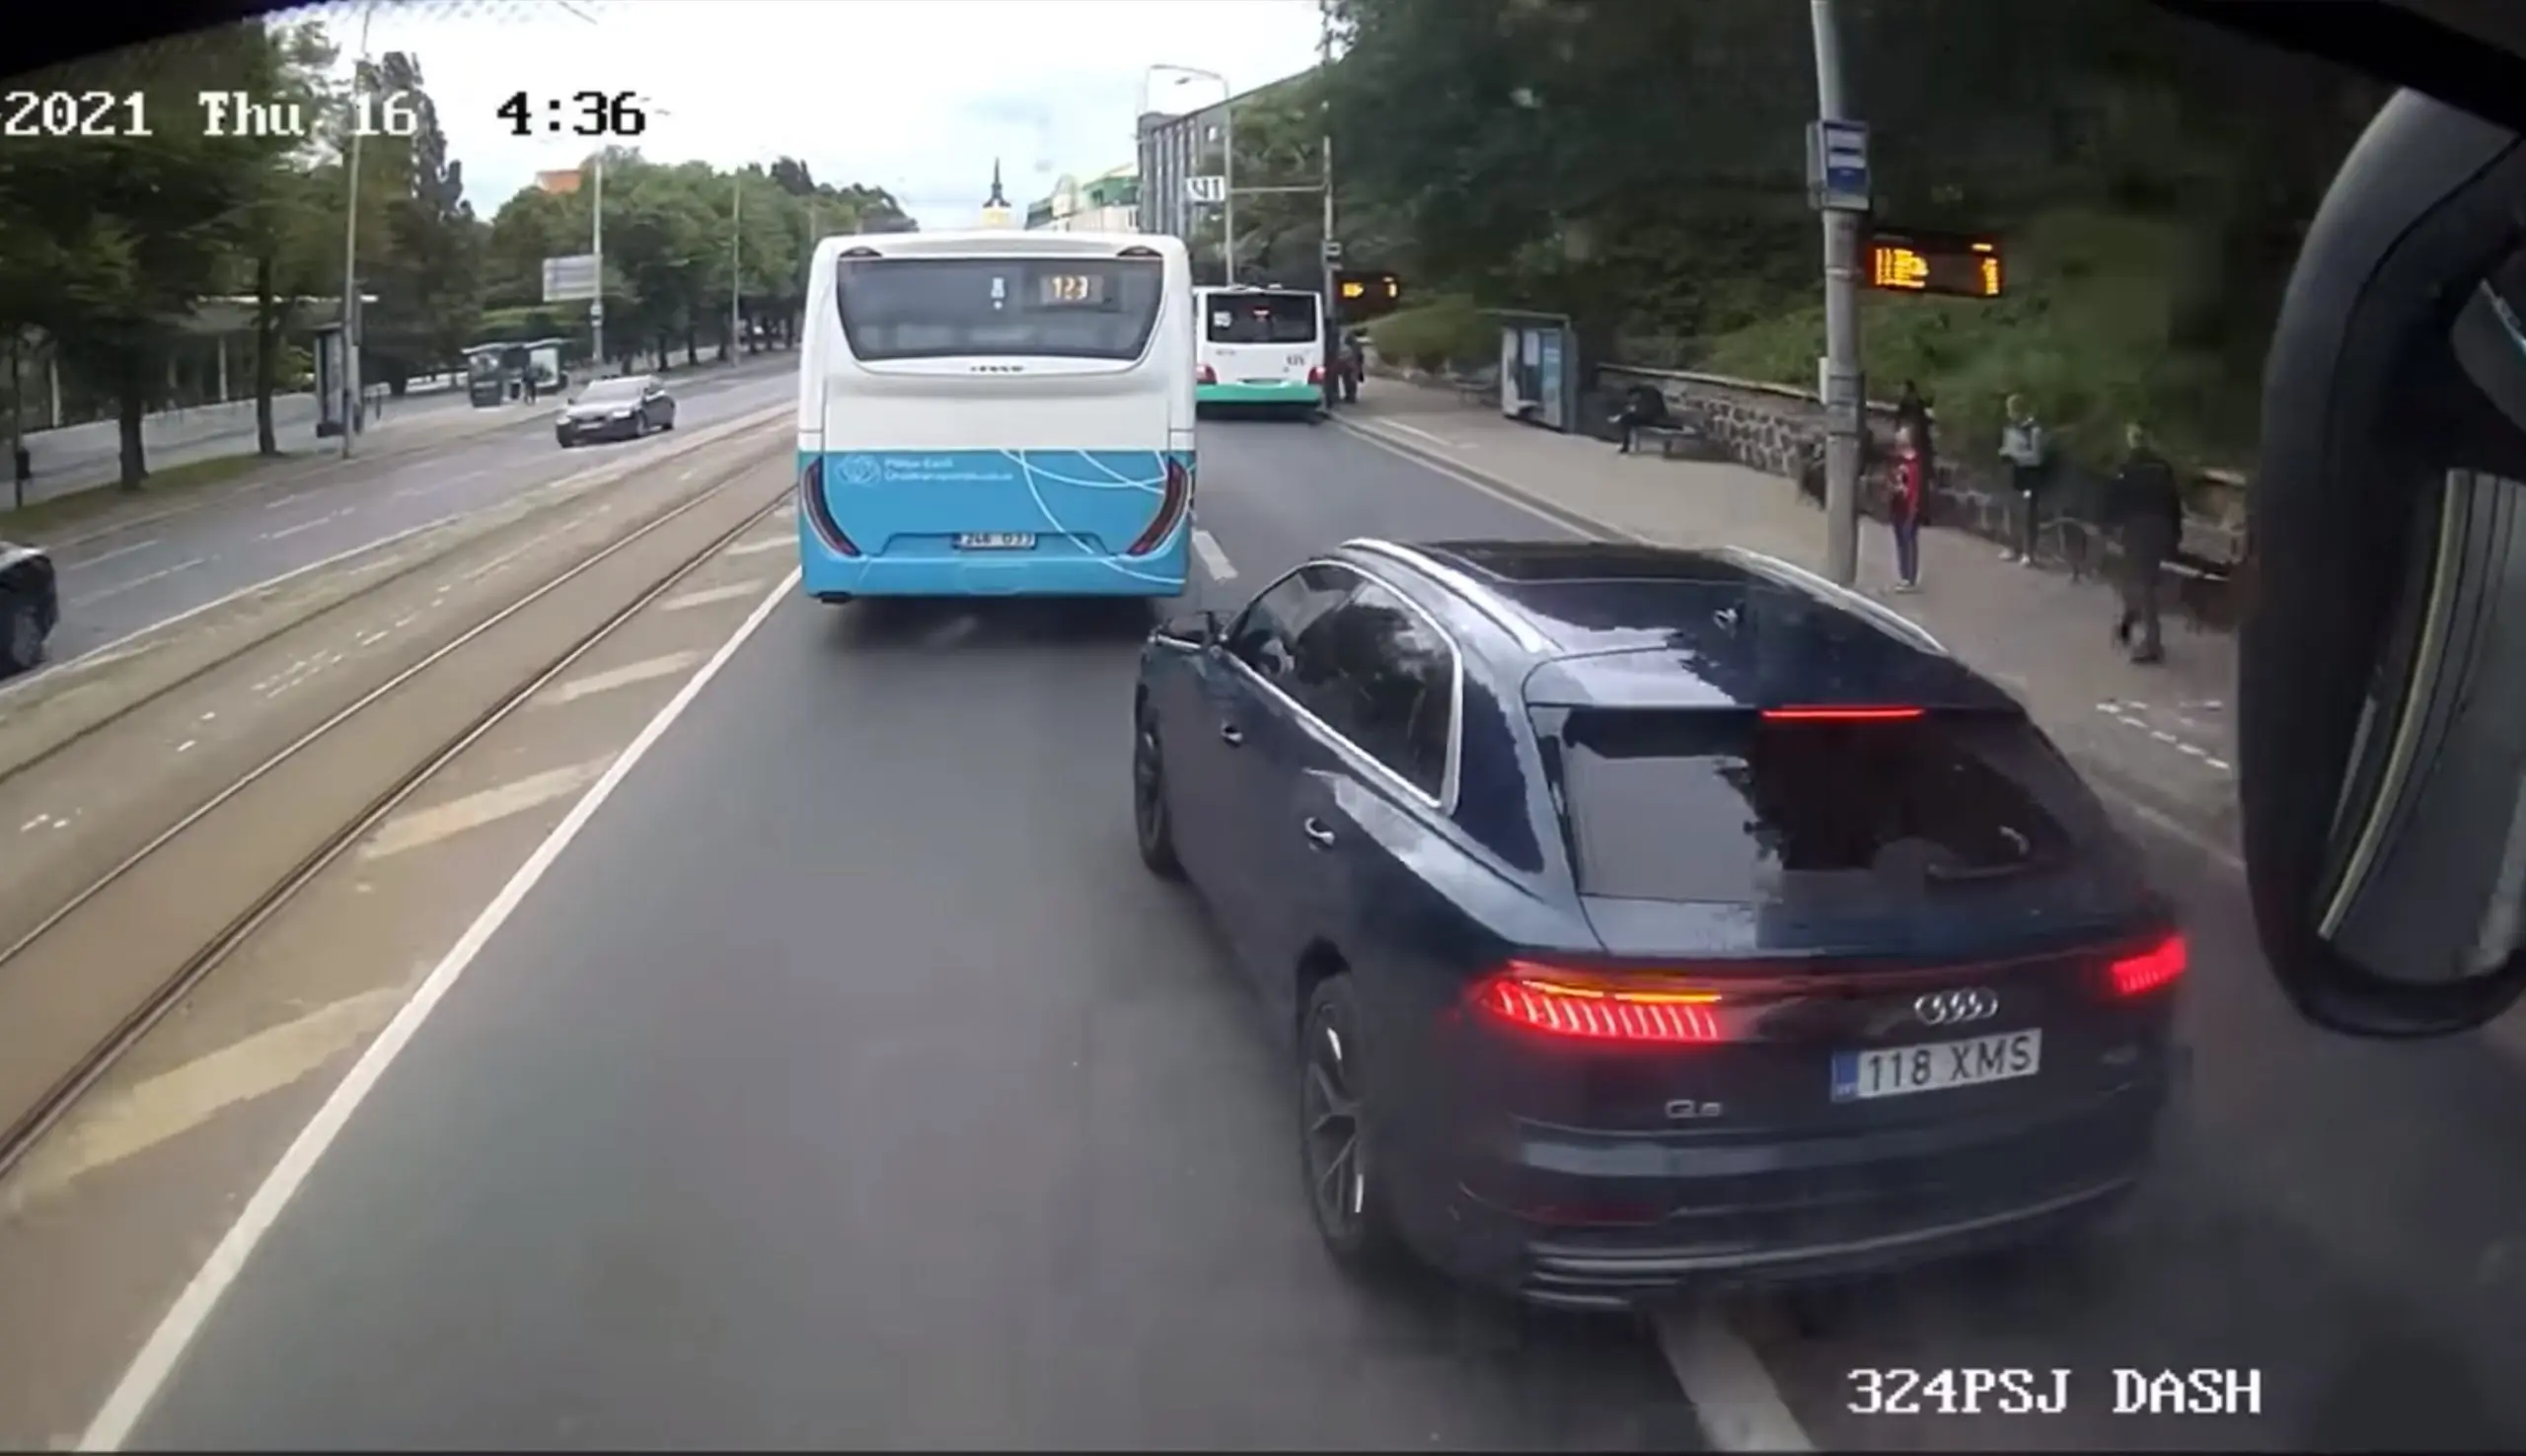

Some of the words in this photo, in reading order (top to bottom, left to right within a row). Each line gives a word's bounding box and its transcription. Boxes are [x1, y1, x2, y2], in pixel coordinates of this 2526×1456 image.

[1052, 275, 1088, 300] 123
[1868, 1049, 1931, 1092] 118
[1950, 1034, 2033, 1082] XMS
